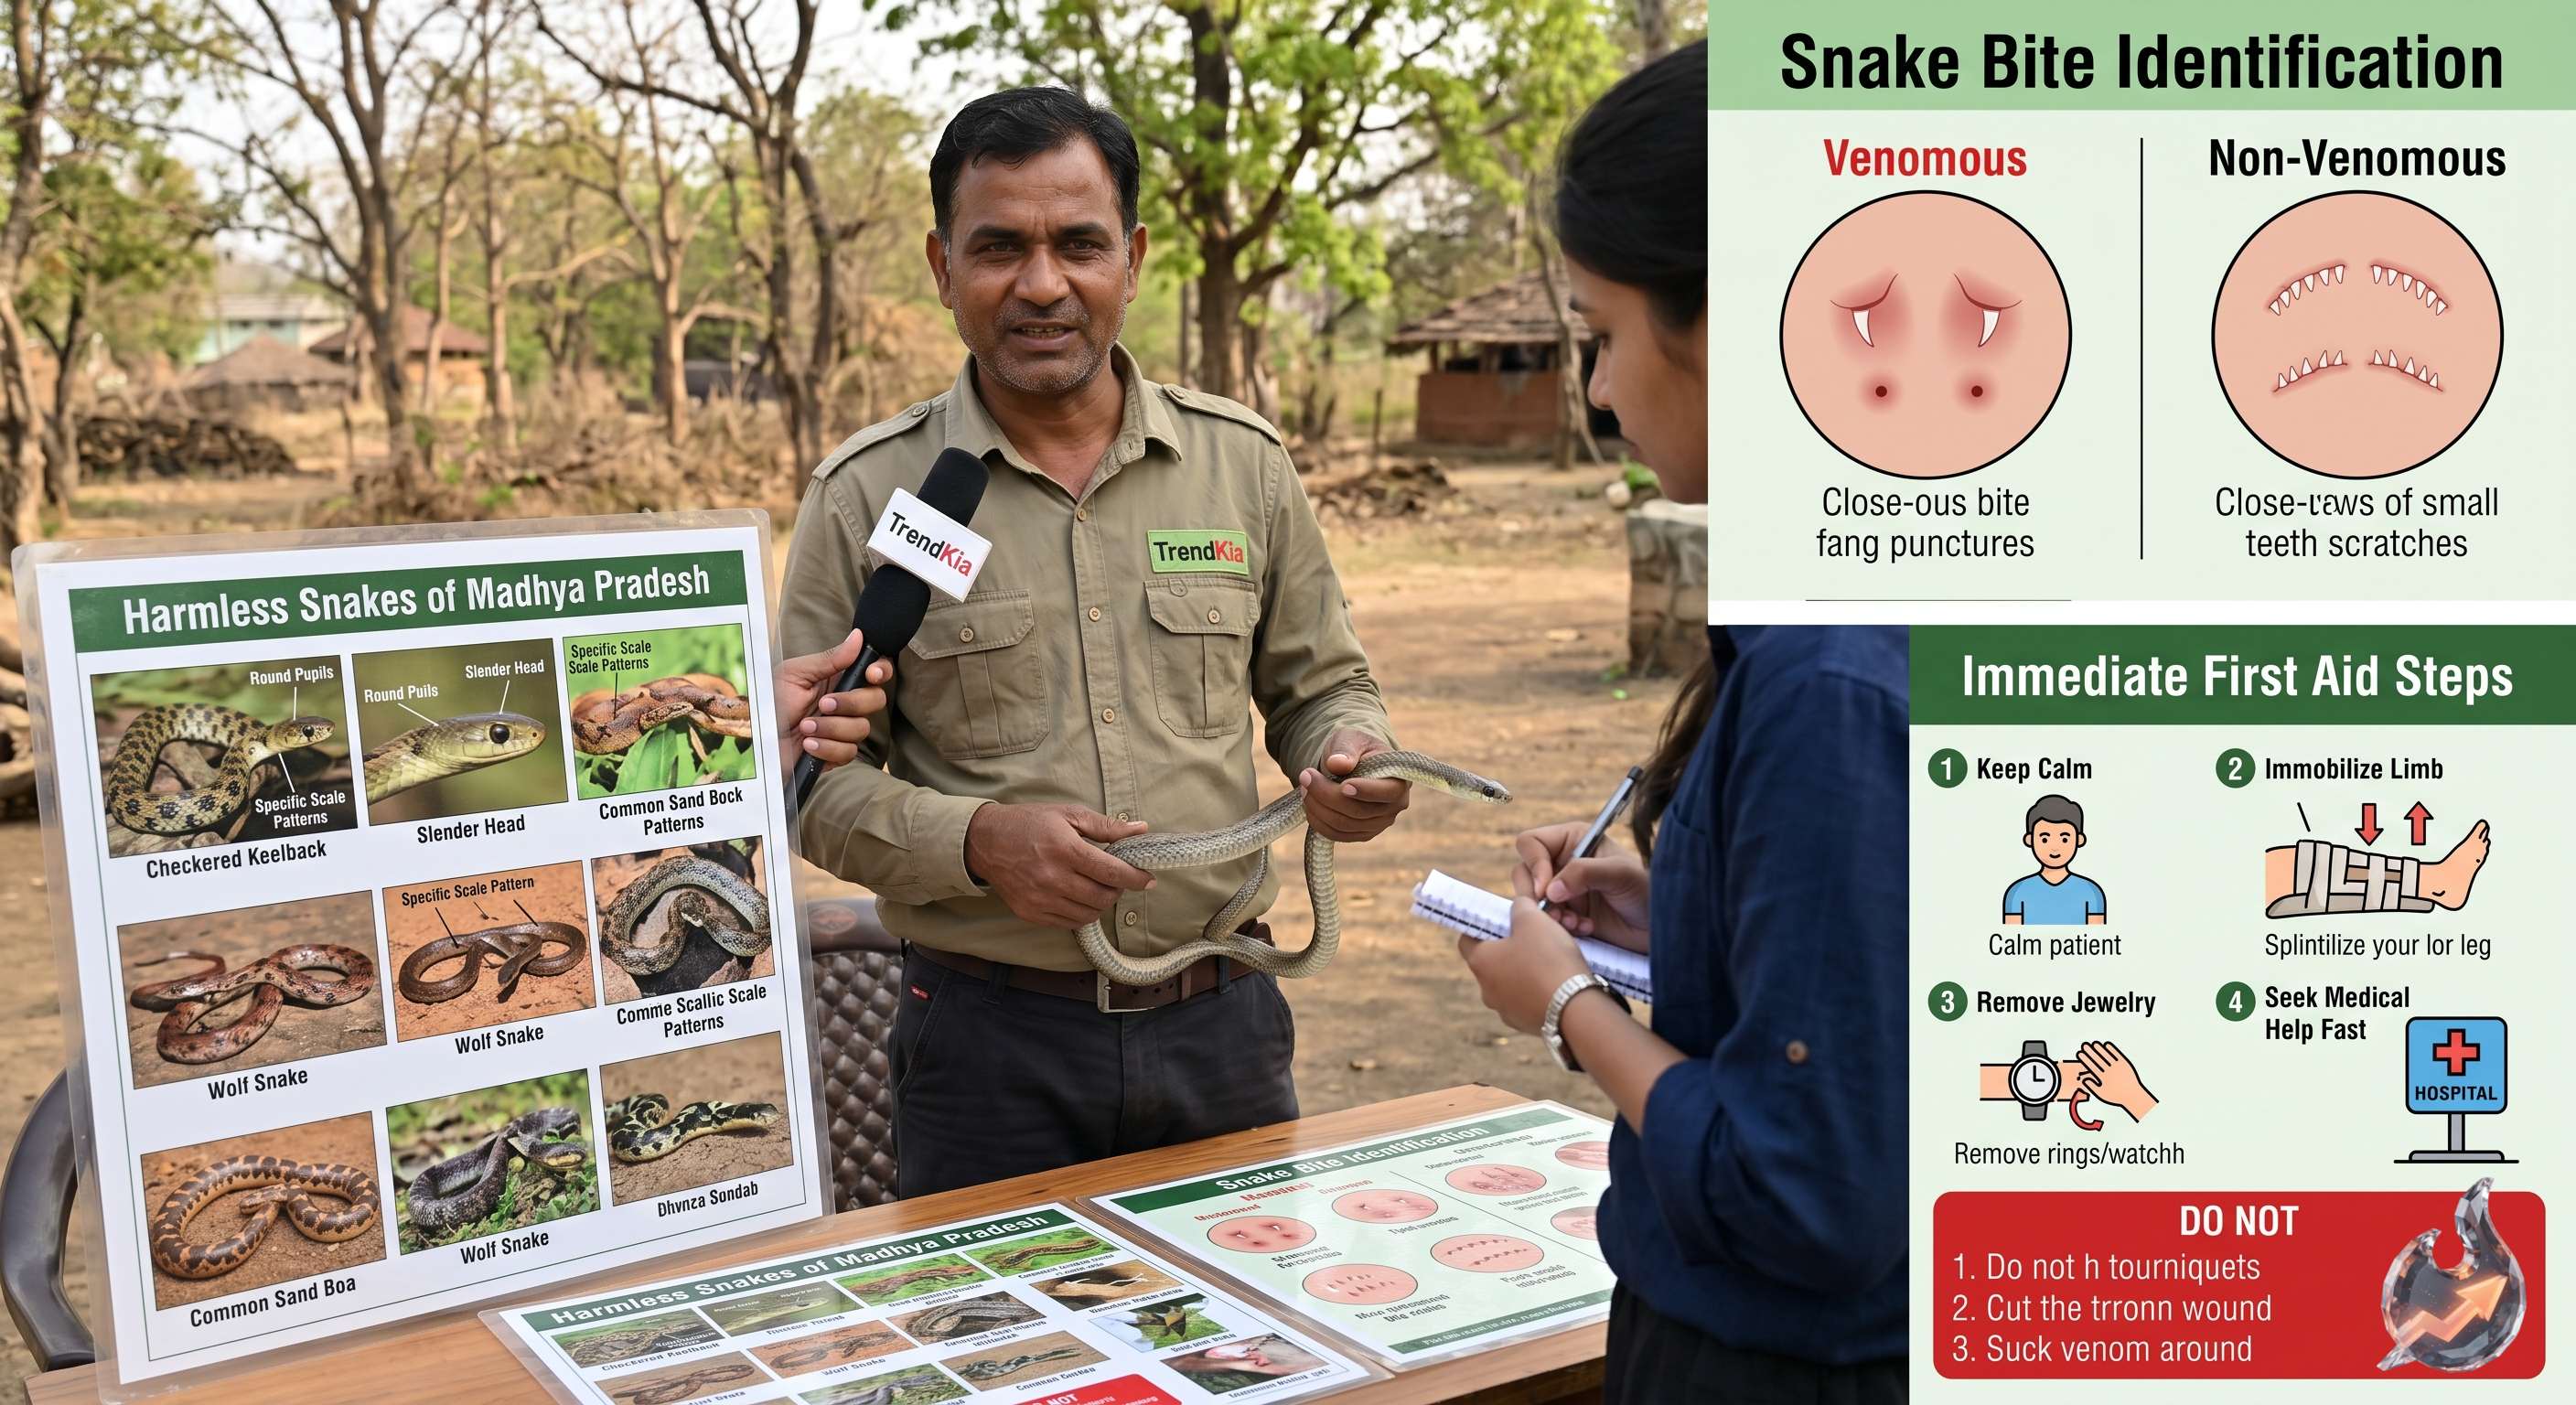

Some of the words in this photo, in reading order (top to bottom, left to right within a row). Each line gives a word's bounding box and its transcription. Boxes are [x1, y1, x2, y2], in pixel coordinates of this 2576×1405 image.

[888, 511, 972, 577] TrendKia
[1154, 541, 1243, 563] TrendKia
[123, 594, 288, 634] Harmless
[300, 585, 416, 621] Snakes
[428, 579, 456, 613] of
[467, 574, 585, 611] Madhya
[595, 564, 709, 601] Pradesh
[572, 643, 617, 660] Specific
[621, 640, 651, 654] Scale
[251, 669, 291, 684] Round
[295, 666, 333, 682] Pupils
[466, 663, 510, 678] Slender
[515, 660, 544, 674] Head
[569, 660, 598, 674] Scale
[602, 659, 649, 671] Patterns
[365, 686, 403, 702] Round
[408, 684, 438, 699] Puils
[255, 795, 306, 815] Specific
[311, 790, 345, 806] Scale
[600, 800, 664, 820] Common
[670, 791, 704, 810] Sand
[710, 787, 743, 805] Bock
[274, 813, 327, 829] Patterns
[417, 822, 478, 843] Slender
[485, 814, 525, 835] Head
[644, 817, 703, 835] Patterns
[147, 850, 242, 878] Checkered
[249, 840, 327, 865] Keelback
[402, 888, 450, 908] Specific
[455, 883, 487, 897] Scale
[491, 878, 534, 893] Pattern
[677, 992, 724, 1013] Scallic
[729, 984, 766, 1003] Scale
[455, 1033, 490, 1054] Wolf
[497, 1026, 543, 1046] Snake
[664, 1016, 724, 1037] Patterns
[208, 1077, 248, 1099] Wolf
[254, 1069, 307, 1091] Snake
[1216, 1169, 1292, 1191] Snake
[1342, 1124, 1490, 1164] Identification
[460, 1241, 496, 1264] Wolf
[502, 1232, 549, 1254] Snake
[551, 1289, 690, 1325] Harmless
[693, 1267, 797, 1298] Snakes
[802, 1258, 830, 1275] of
[834, 1238, 942, 1268] Madhya
[948, 1216, 1049, 1245] Pradesh
[191, 1298, 268, 1327] Common
[275, 1282, 317, 1307] Sand
[324, 1278, 355, 1296] Boa
